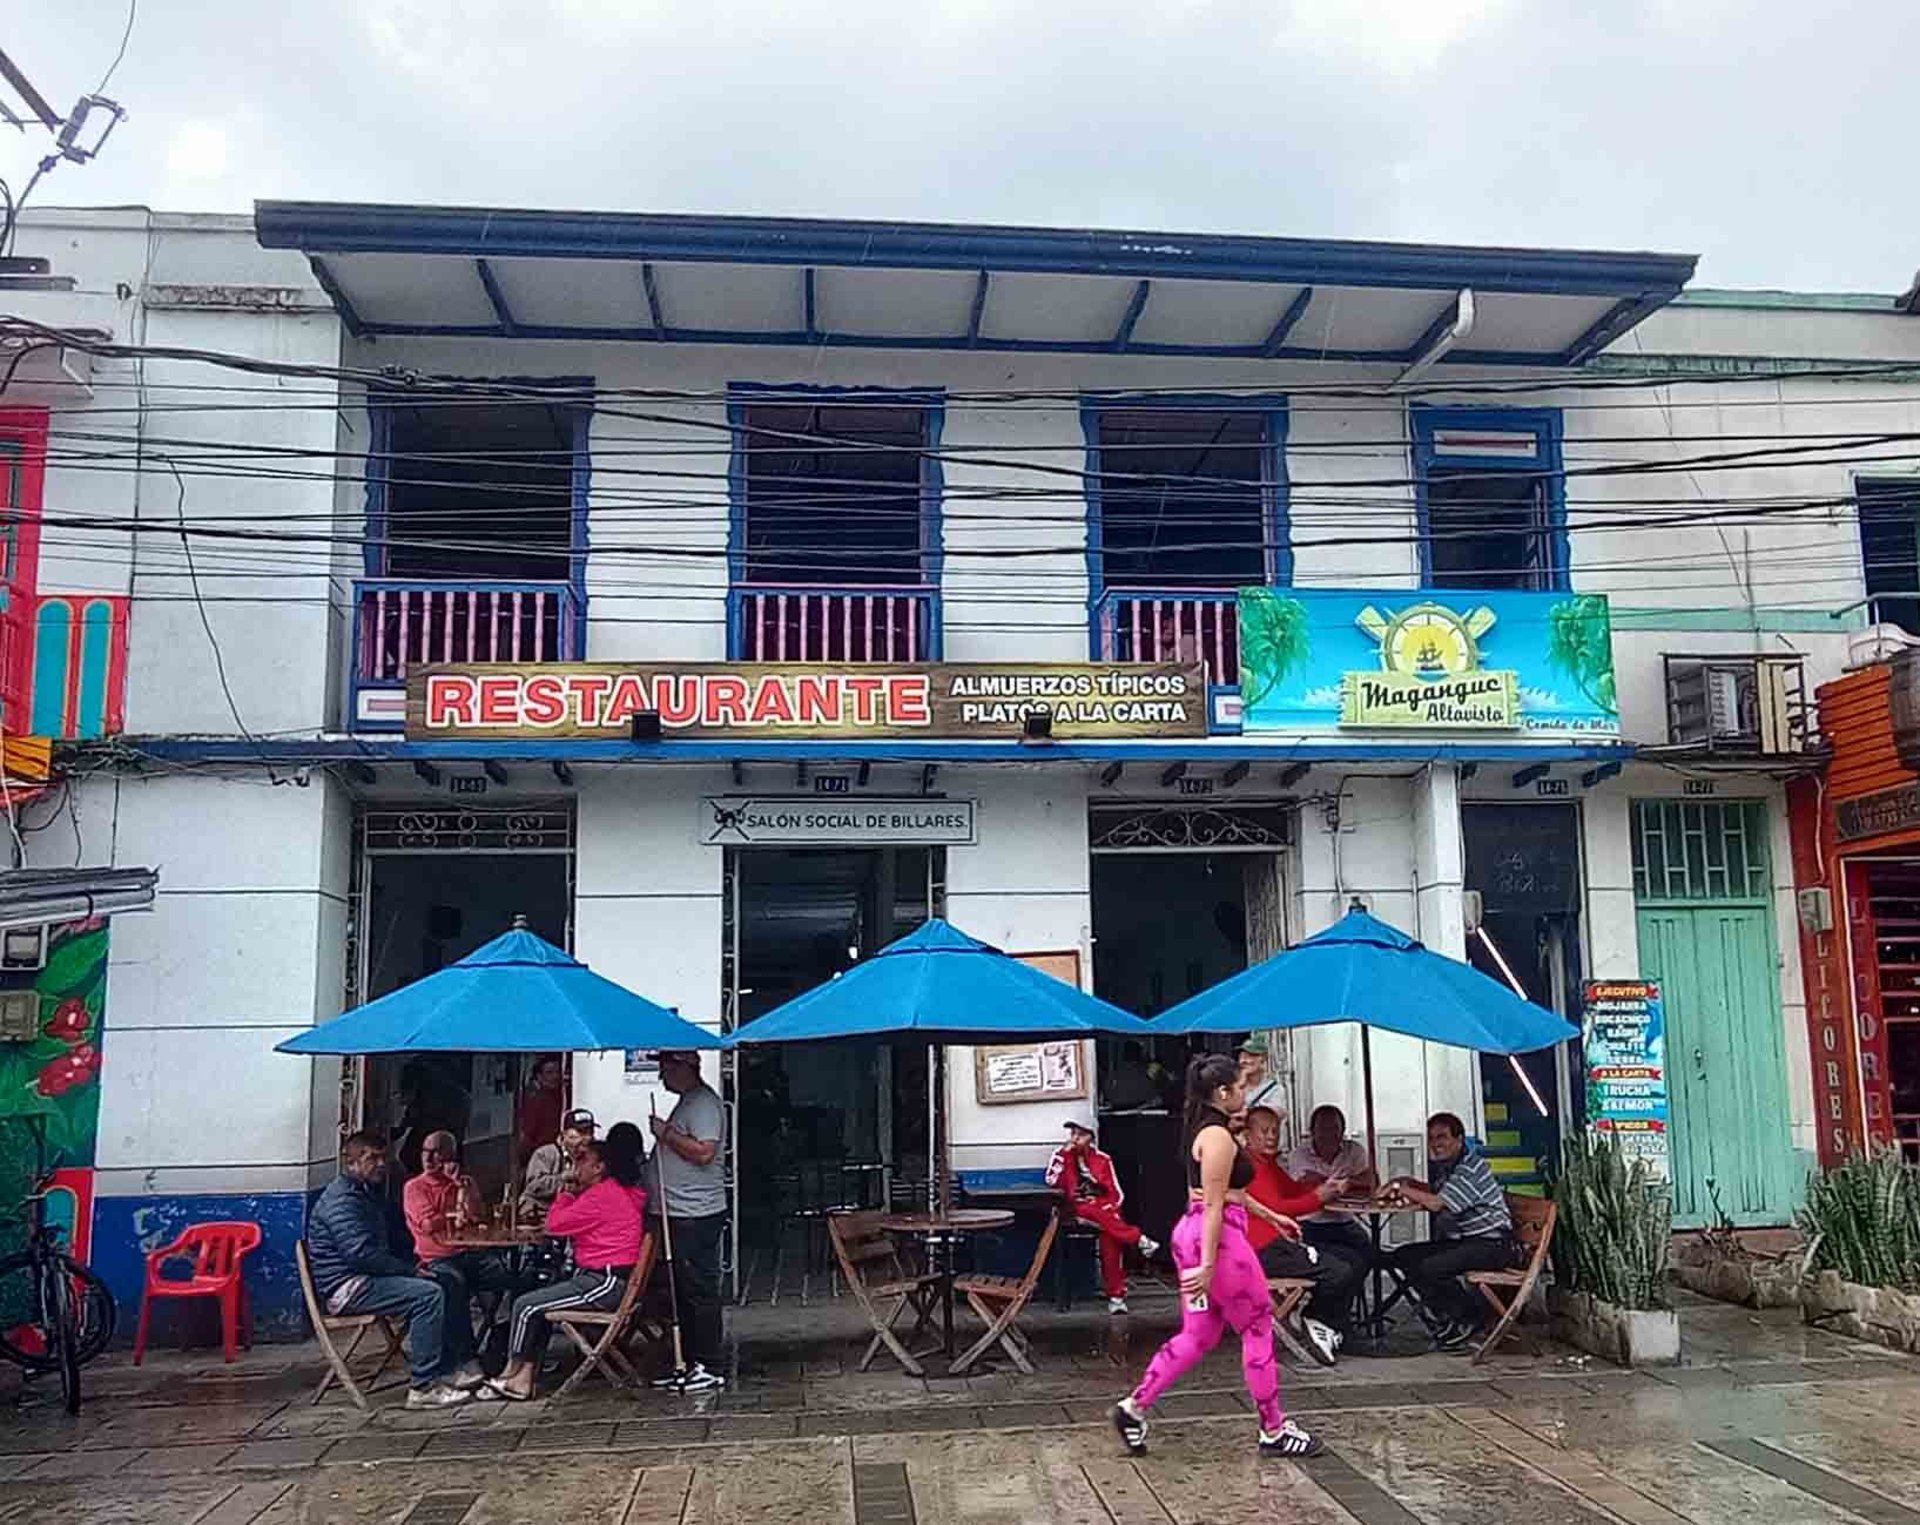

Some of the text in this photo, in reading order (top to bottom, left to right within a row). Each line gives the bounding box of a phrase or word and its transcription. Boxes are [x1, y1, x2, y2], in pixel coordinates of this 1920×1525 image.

[951, 671, 1185, 696] ALMUERZOS TÍPICOS
[425, 674, 931, 728] RESTAURANTE
[1426, 703, 1504, 721] Altavista
[1055, 704, 1073, 722] A
[1078, 704, 1107, 722] LA
[1113, 703, 1187, 722] CARTA
[806, 814, 861, 828] SOCIAL
[866, 814, 886, 828] DE
[1816, 934, 1845, 1154] LICORES
